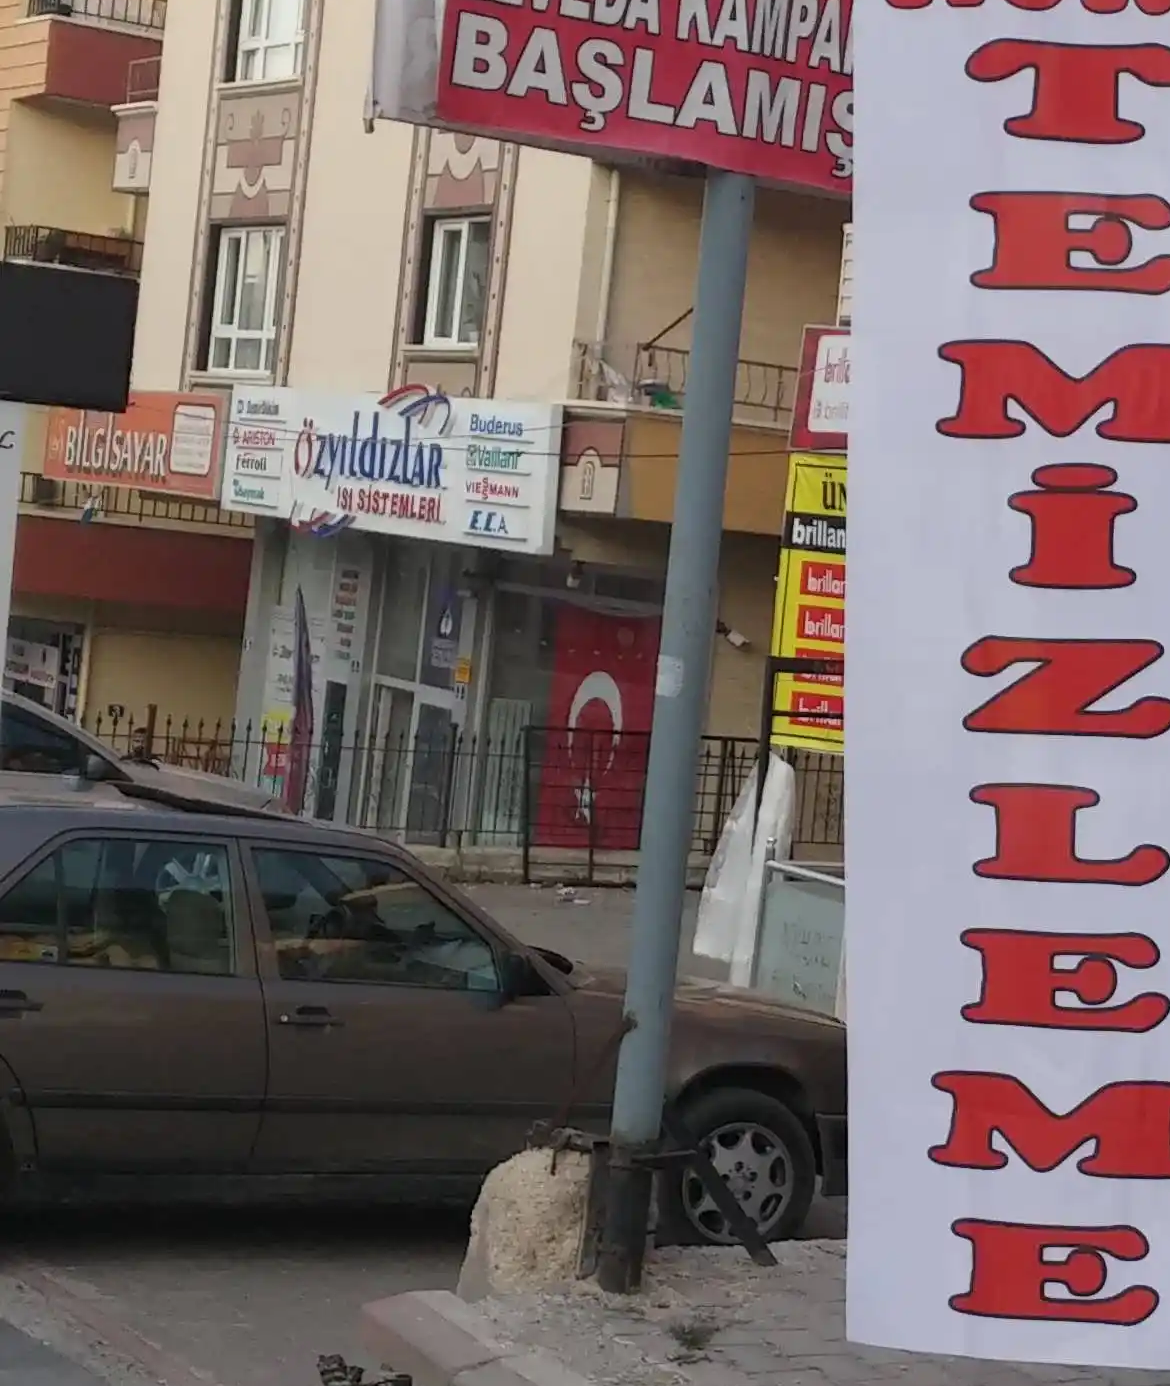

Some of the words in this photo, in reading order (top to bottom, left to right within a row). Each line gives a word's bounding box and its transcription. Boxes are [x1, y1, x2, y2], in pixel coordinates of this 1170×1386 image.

[470, 413, 525, 438] Buderus
[337, 487, 353, 516] ISI
[357, 485, 444, 525] SİSTEMLERİ
